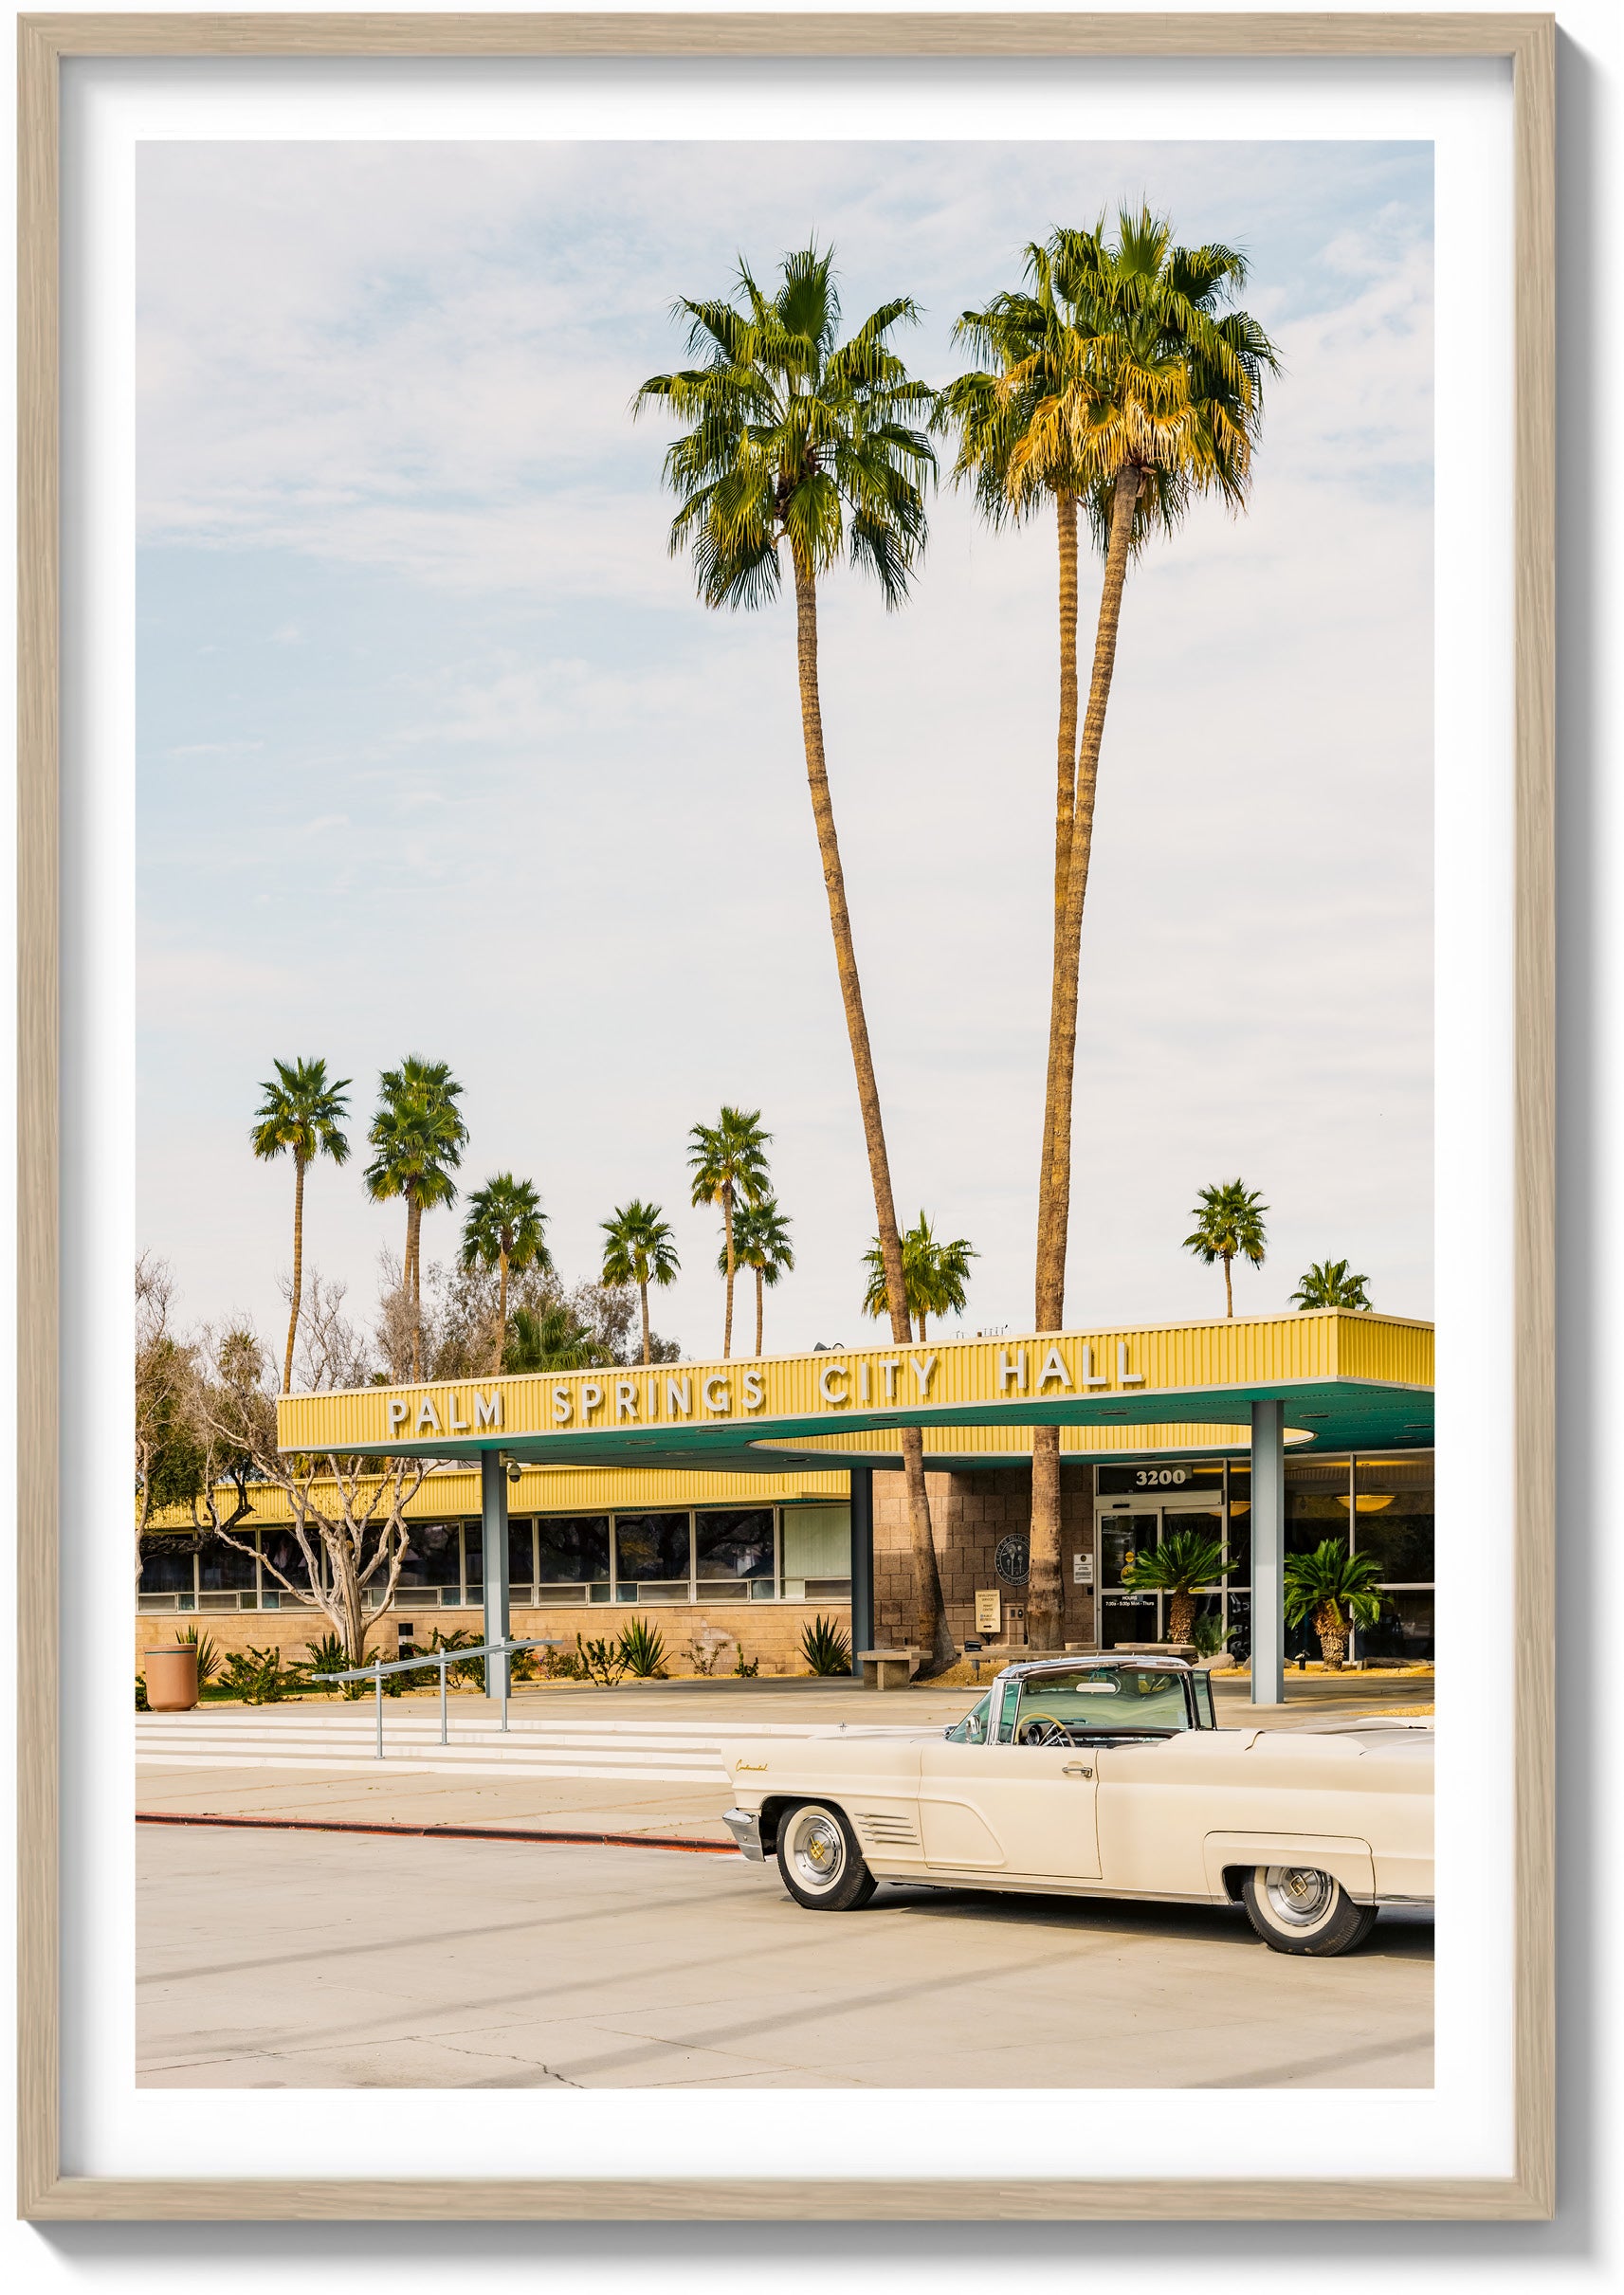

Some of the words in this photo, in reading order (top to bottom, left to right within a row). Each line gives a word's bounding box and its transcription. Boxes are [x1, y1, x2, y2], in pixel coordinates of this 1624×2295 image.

[388, 1391, 504, 1434] PALM
[551, 1371, 765, 1423] SPRINGS
[818, 1356, 938, 1403] CITY
[999, 1341, 1145, 1391] HALL
[1136, 1469, 1186, 1486] 3200
